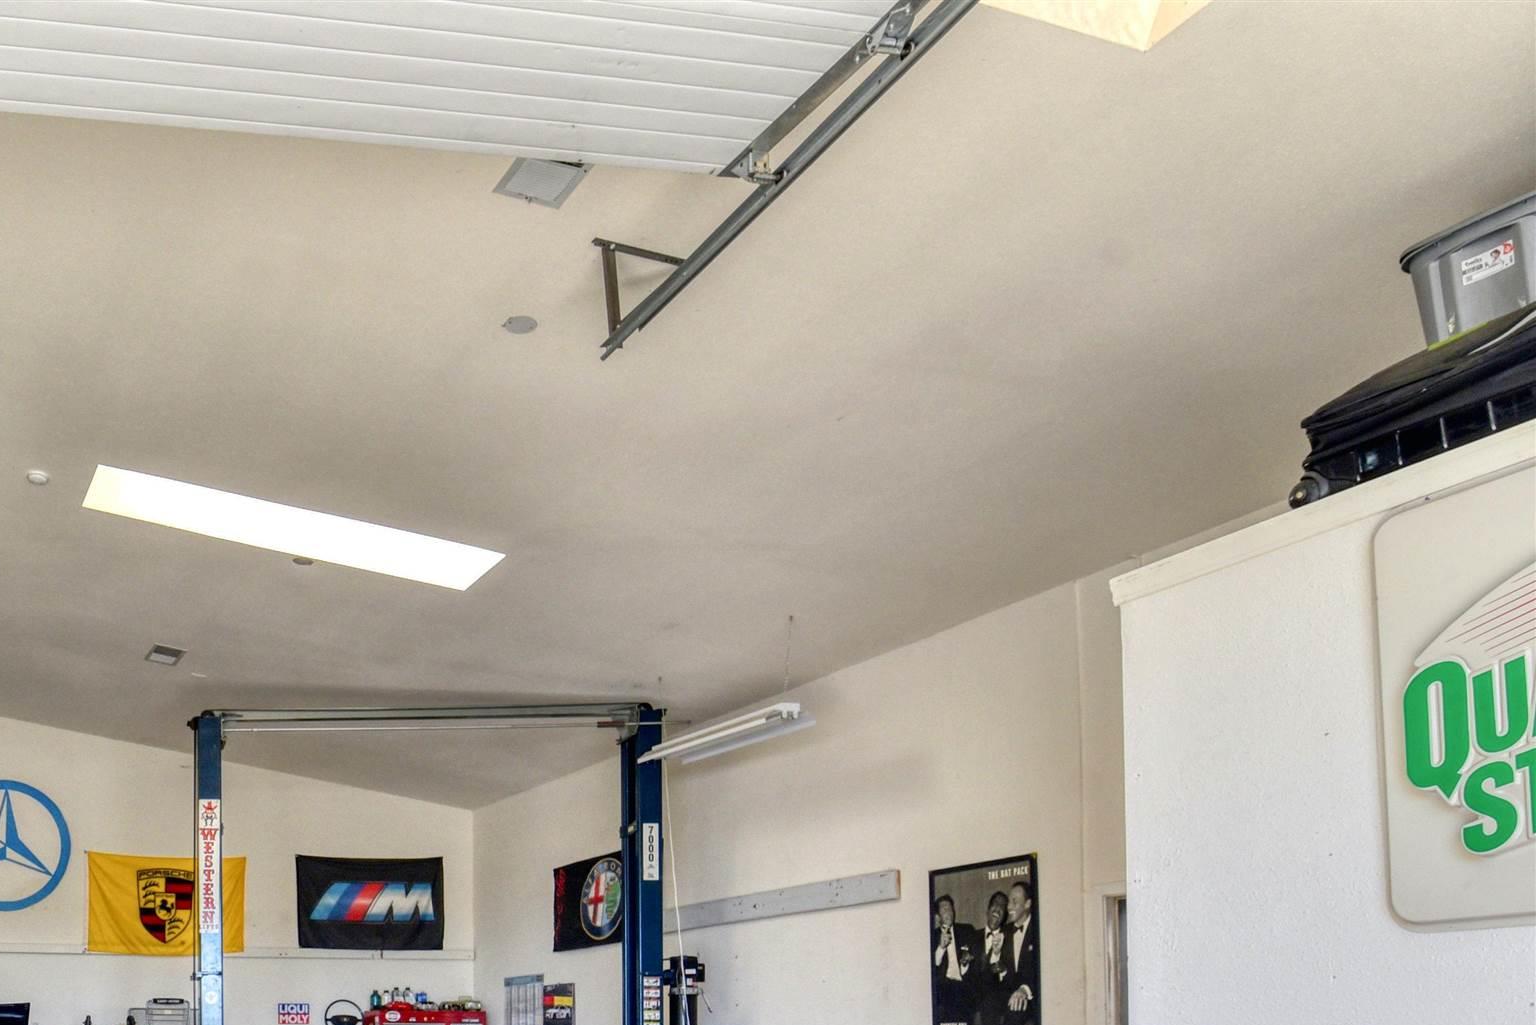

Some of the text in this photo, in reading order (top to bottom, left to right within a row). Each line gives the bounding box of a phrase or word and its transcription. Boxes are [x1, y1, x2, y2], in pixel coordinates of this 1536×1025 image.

[1403, 655, 1536, 800] QU
[199, 828, 219, 924] WESTERN
[279, 1004, 309, 1014] LIQUI
[279, 1014, 309, 1024] MOLY
